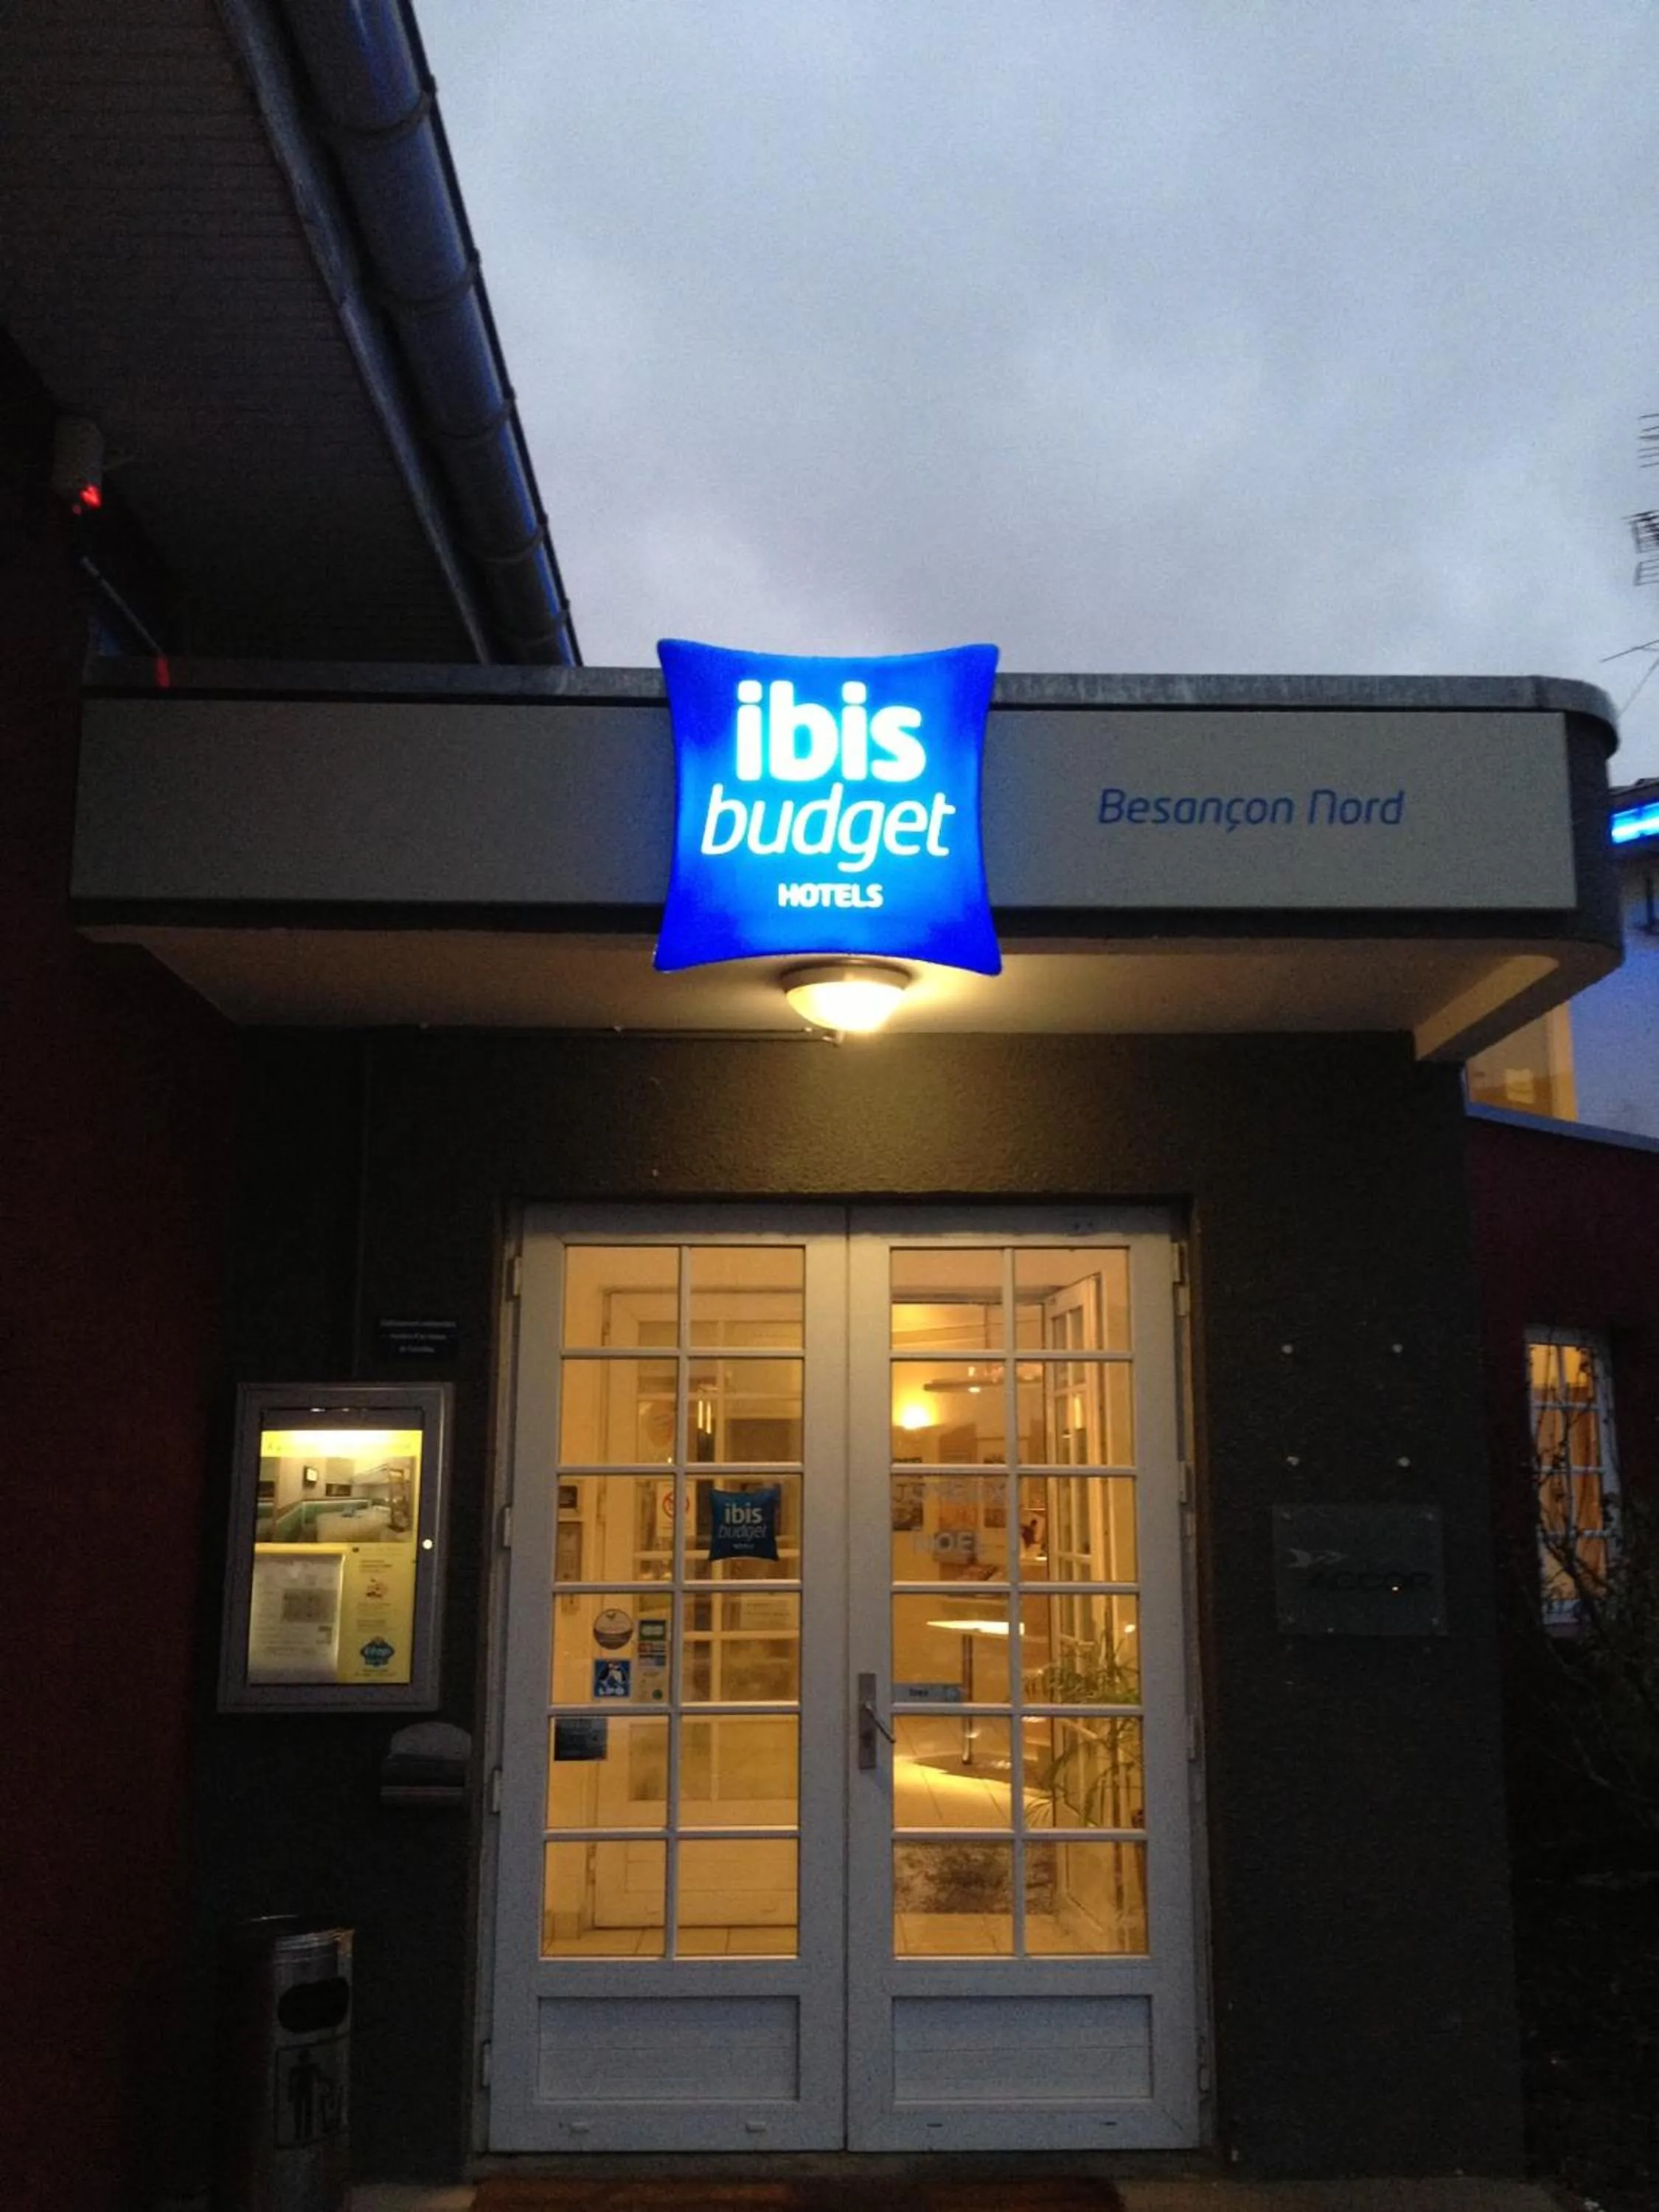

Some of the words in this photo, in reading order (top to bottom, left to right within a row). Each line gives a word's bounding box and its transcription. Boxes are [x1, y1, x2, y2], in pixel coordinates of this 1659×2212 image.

[736, 679, 927, 782] ibis
[700, 782, 956, 873] budget
[1098, 787, 1295, 833] Besançon
[1307, 789, 1406, 826] Nord
[777, 882, 884, 909] HOTELS
[724, 1502, 763, 1525] ibis
[717, 1523, 767, 1542] budget
